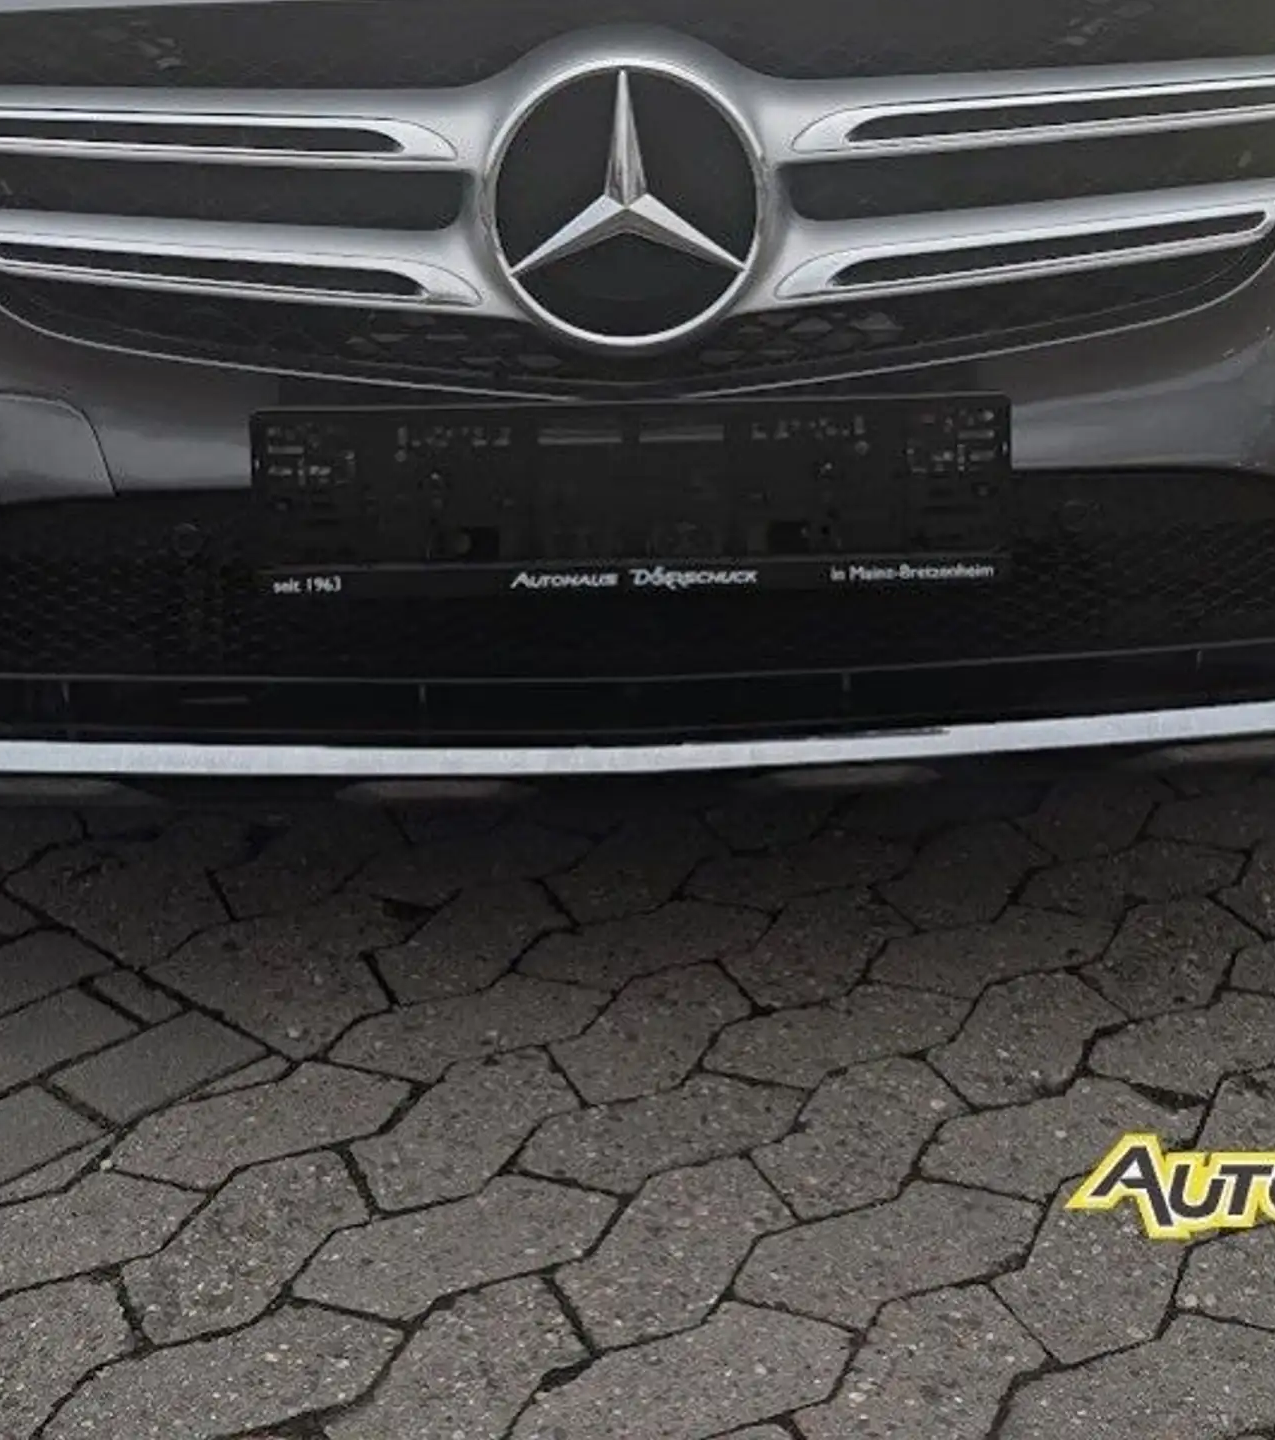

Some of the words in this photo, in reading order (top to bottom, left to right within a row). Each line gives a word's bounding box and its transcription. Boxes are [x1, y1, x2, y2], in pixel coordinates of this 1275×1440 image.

[272, 577, 301, 594] seit
[307, 575, 342, 593] 1963
[511, 571, 619, 589] AUTOHAUS
[831, 567, 846, 581] in
[849, 563, 995, 581] Mainz-Bretzenheim
